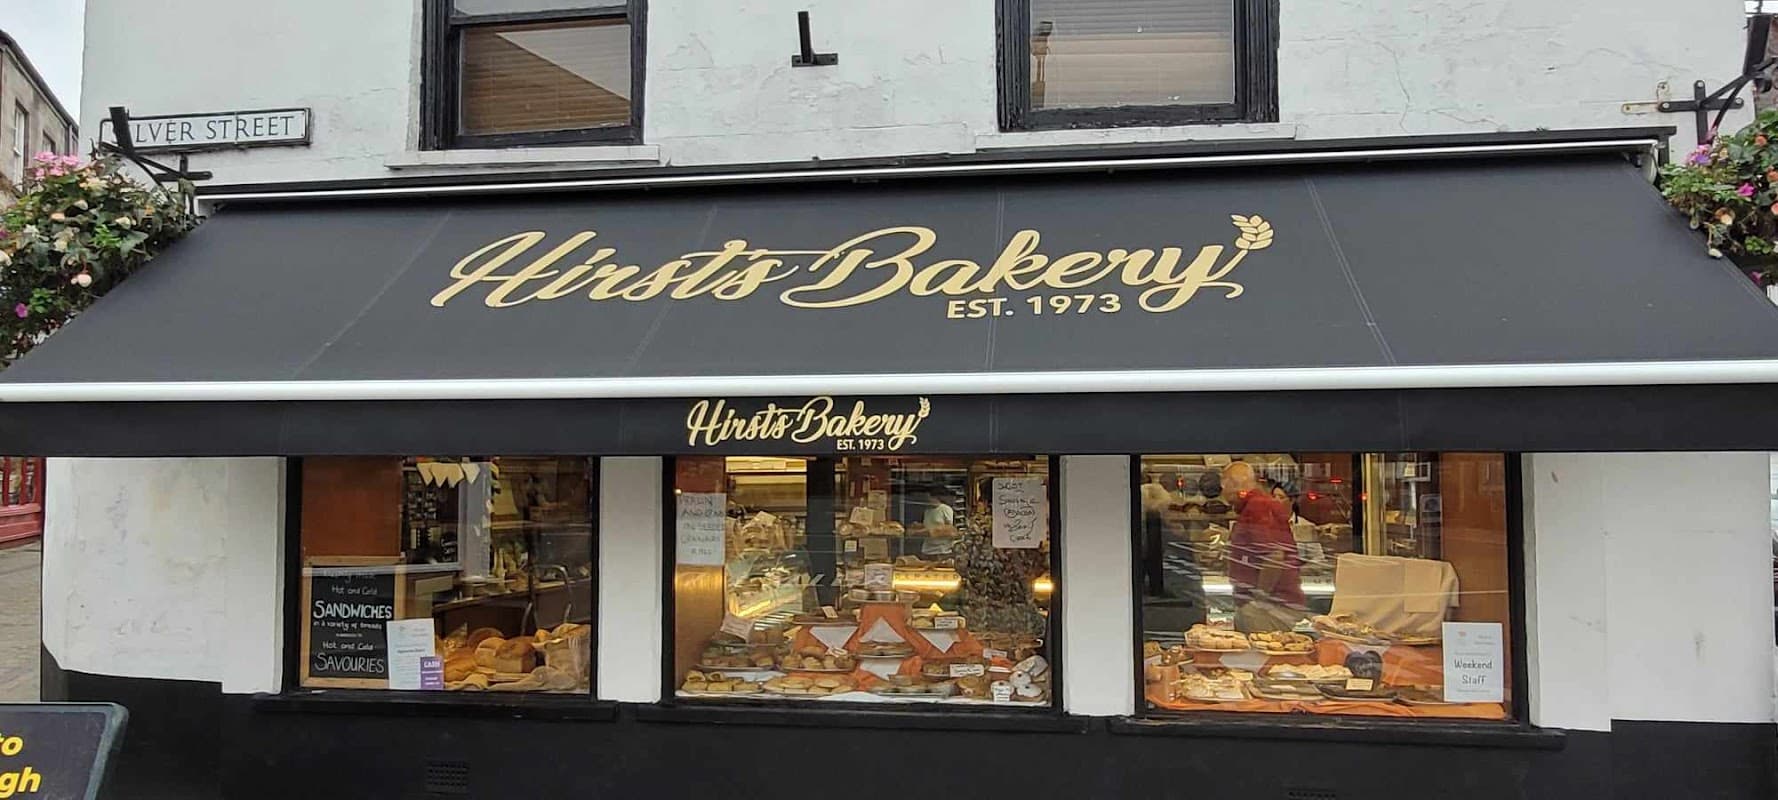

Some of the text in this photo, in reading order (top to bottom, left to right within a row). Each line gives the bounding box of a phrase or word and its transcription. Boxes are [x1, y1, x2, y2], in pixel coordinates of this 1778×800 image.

[113, 116, 295, 144] LVER STREET
[780, 226, 1244, 314] Bakery
[946, 294, 1122, 319] EST. 1973
[791, 396, 918, 451] Bakery
[837, 439, 884, 450] EST. 1973
[313, 600, 393, 619] SANDWICHES
[314, 651, 385, 674] SAVOURIES
[1454, 658, 1493, 670] Weekend
[1462, 674, 1487, 685] Staff
